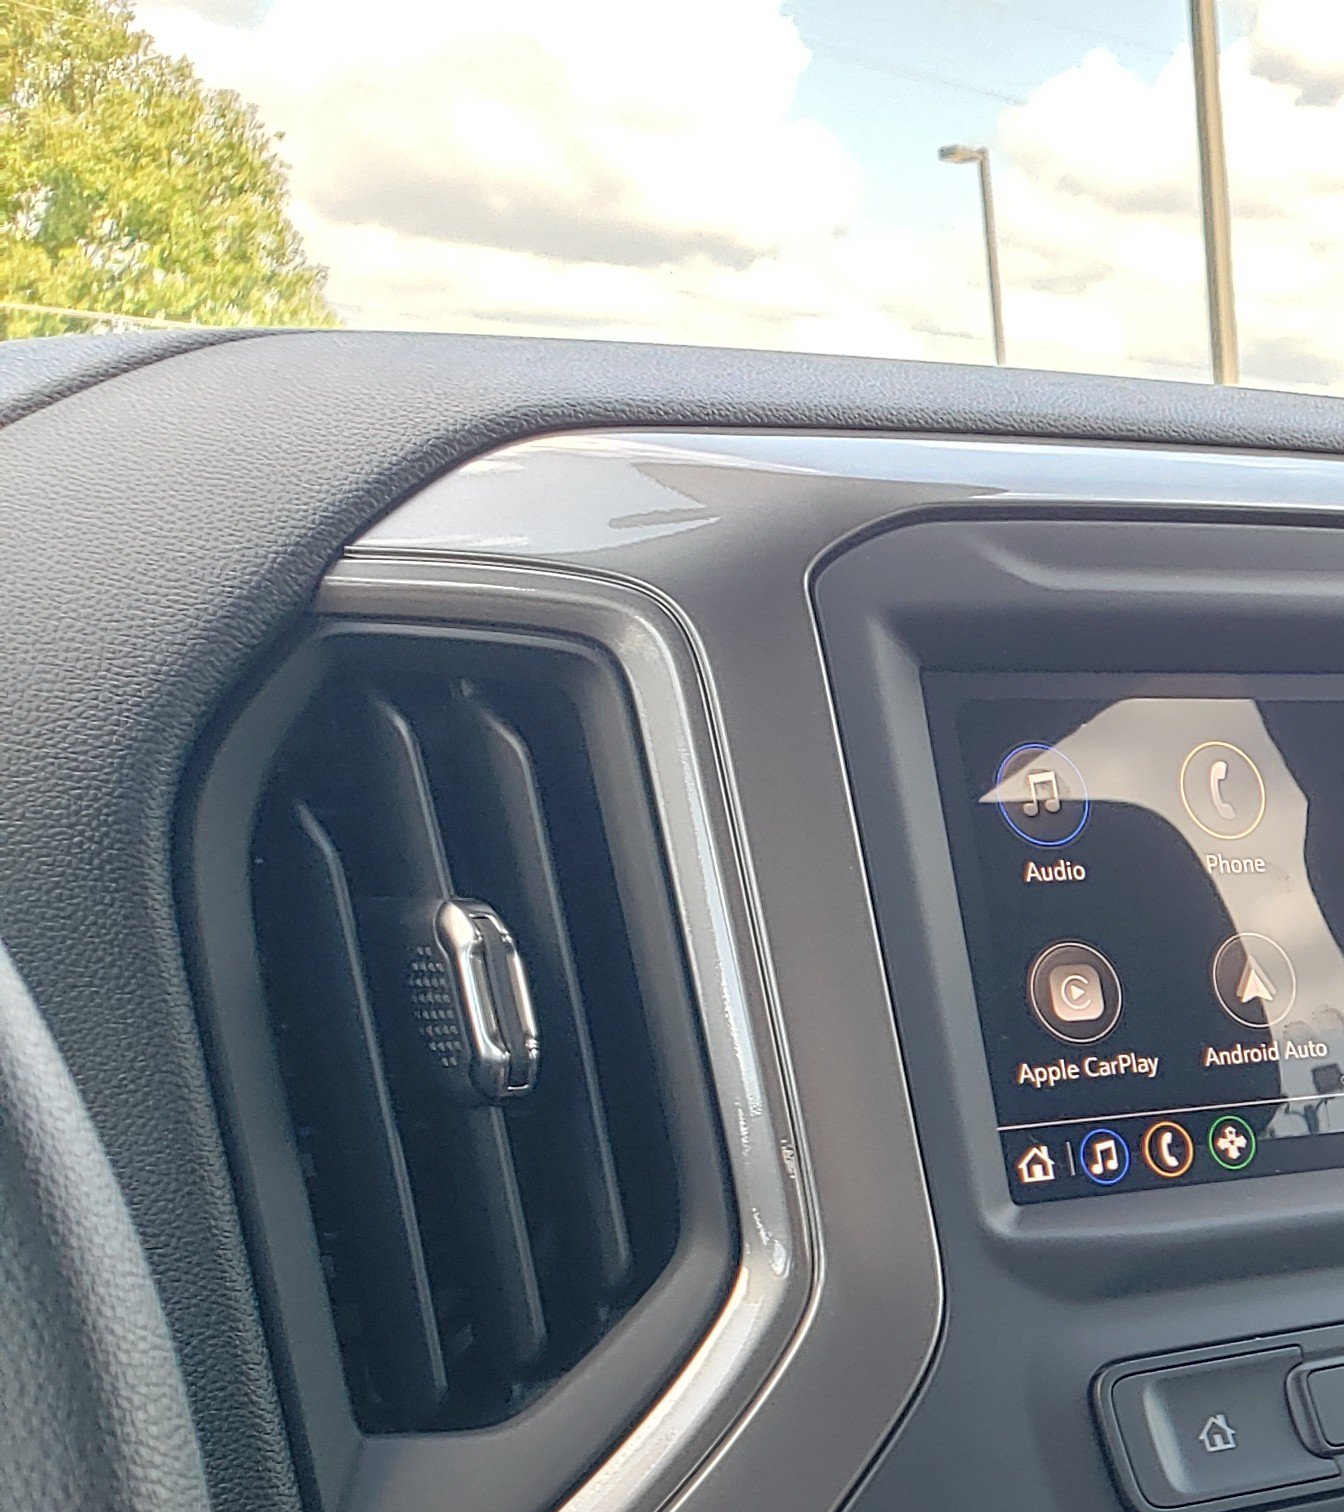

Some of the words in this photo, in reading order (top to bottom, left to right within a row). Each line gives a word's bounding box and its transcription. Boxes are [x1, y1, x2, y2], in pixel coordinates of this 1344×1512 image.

[1024, 859, 1086, 882] Audio
[1205, 854, 1266, 874] Phone
[1204, 1041, 1278, 1067] Android
[1284, 1039, 1328, 1060] Auto
[1017, 1058, 1080, 1088] Apple
[1084, 1053, 1159, 1079] CarPlay
